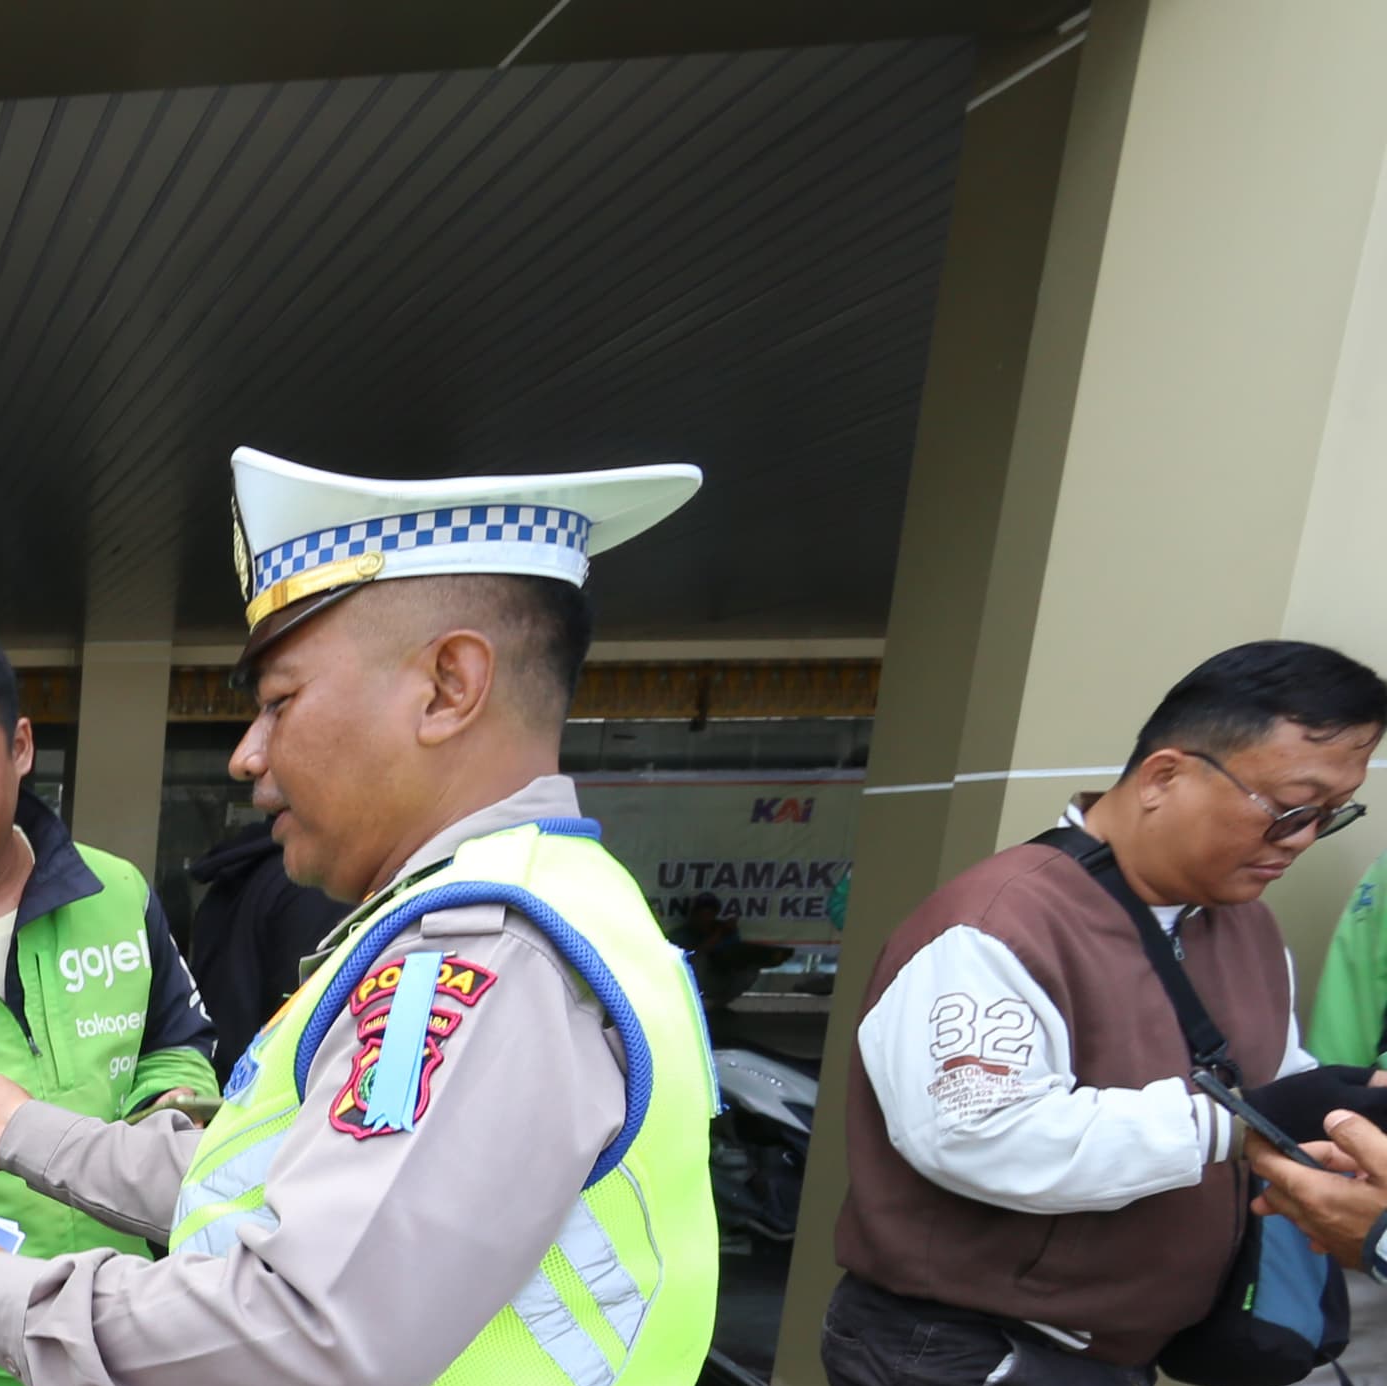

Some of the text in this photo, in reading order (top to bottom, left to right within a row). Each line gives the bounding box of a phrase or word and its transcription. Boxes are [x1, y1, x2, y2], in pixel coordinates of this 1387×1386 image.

[657, 861, 853, 890] UTAMAK
[358, 962, 476, 1002] PODA
[929, 992, 1037, 1067] 32
